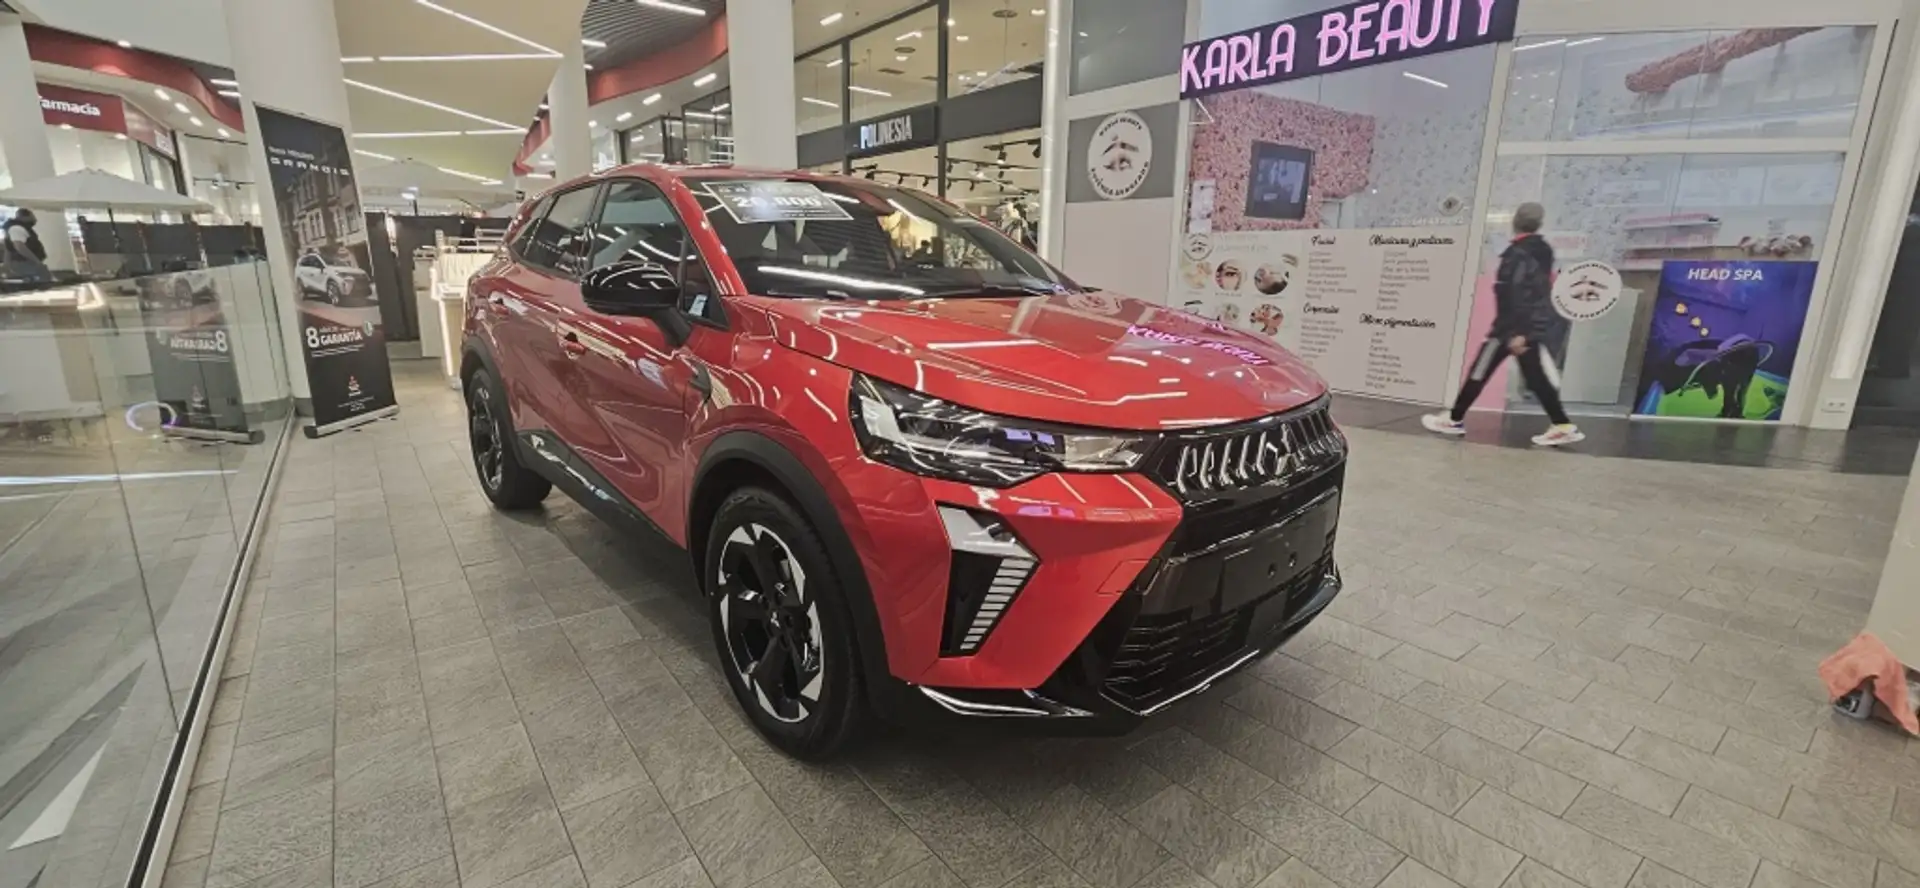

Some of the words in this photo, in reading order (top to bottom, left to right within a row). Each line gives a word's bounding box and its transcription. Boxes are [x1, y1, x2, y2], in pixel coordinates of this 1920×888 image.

[1180, 24, 1296, 93] KARLA
[1316, 0, 1494, 67] BEAUTY
[39, 96, 101, 116] armacia
[860, 114, 912, 149] POLINESIA
[270, 156, 350, 176] GRANDIS
[1687, 267, 1730, 281] HEAD
[1732, 268, 1763, 281] SPA
[305, 325, 320, 348] 8
[320, 328, 363, 346] GARANTÍA
